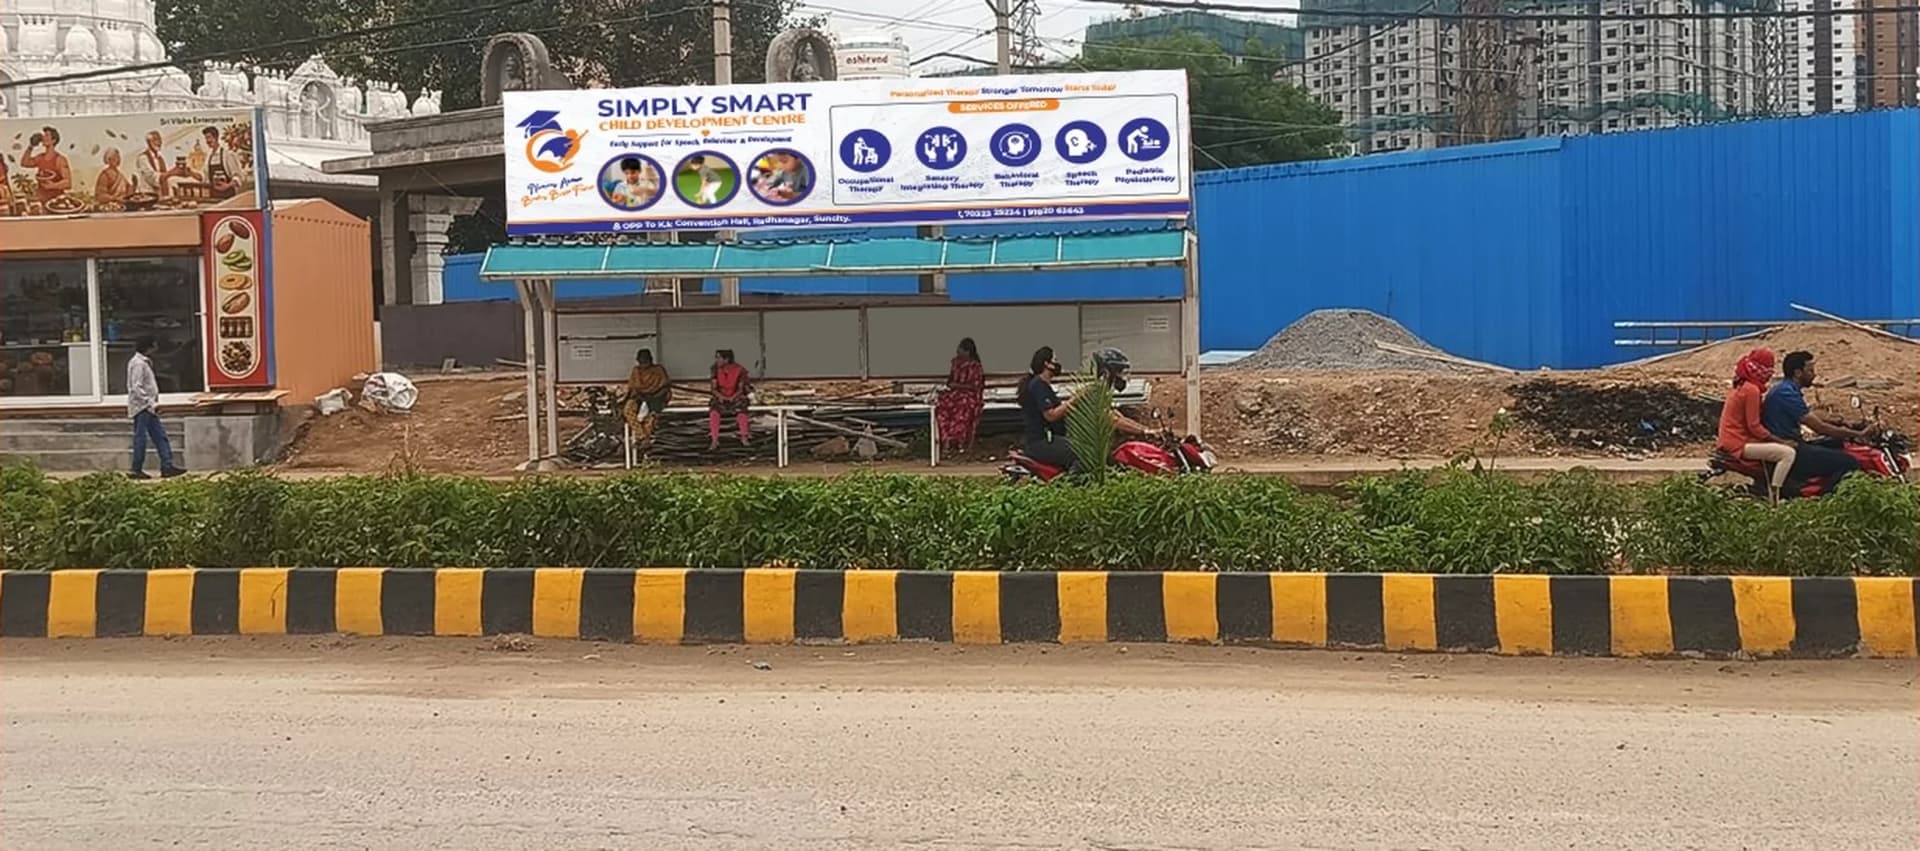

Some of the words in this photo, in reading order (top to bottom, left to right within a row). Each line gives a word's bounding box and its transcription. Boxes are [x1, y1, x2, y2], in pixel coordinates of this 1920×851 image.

[981, 87, 1019, 96] Stronger
[1020, 86, 1063, 94] Tomorrow
[598, 95, 703, 118] SIMPLY
[711, 92, 812, 115] SMART
[960, 102, 1005, 112] SERVICES
[1006, 100, 1047, 110] OFFERED
[193, 116, 234, 124] Enterprises
[598, 119, 642, 132] CHILD
[645, 115, 749, 130] DEVELOPMENT
[752, 113, 806, 126] CENTRE
[630, 140, 659, 149] Support
[661, 138, 673, 148] for
[674, 138, 701, 147] Speech
[925, 174, 959, 183] Sensory
[1066, 170, 1098, 179] Speech
[838, 176, 894, 185] Occupational
[1000, 179, 1034, 188] Therapy
[1065, 178, 1099, 187] Therapy
[849, 185, 883, 193] Therapy
[950, 181, 985, 190] Therapy
[675, 218, 728, 228] Convention
[730, 217, 750, 227] Hall,
[813, 213, 850, 223] Suncity.
